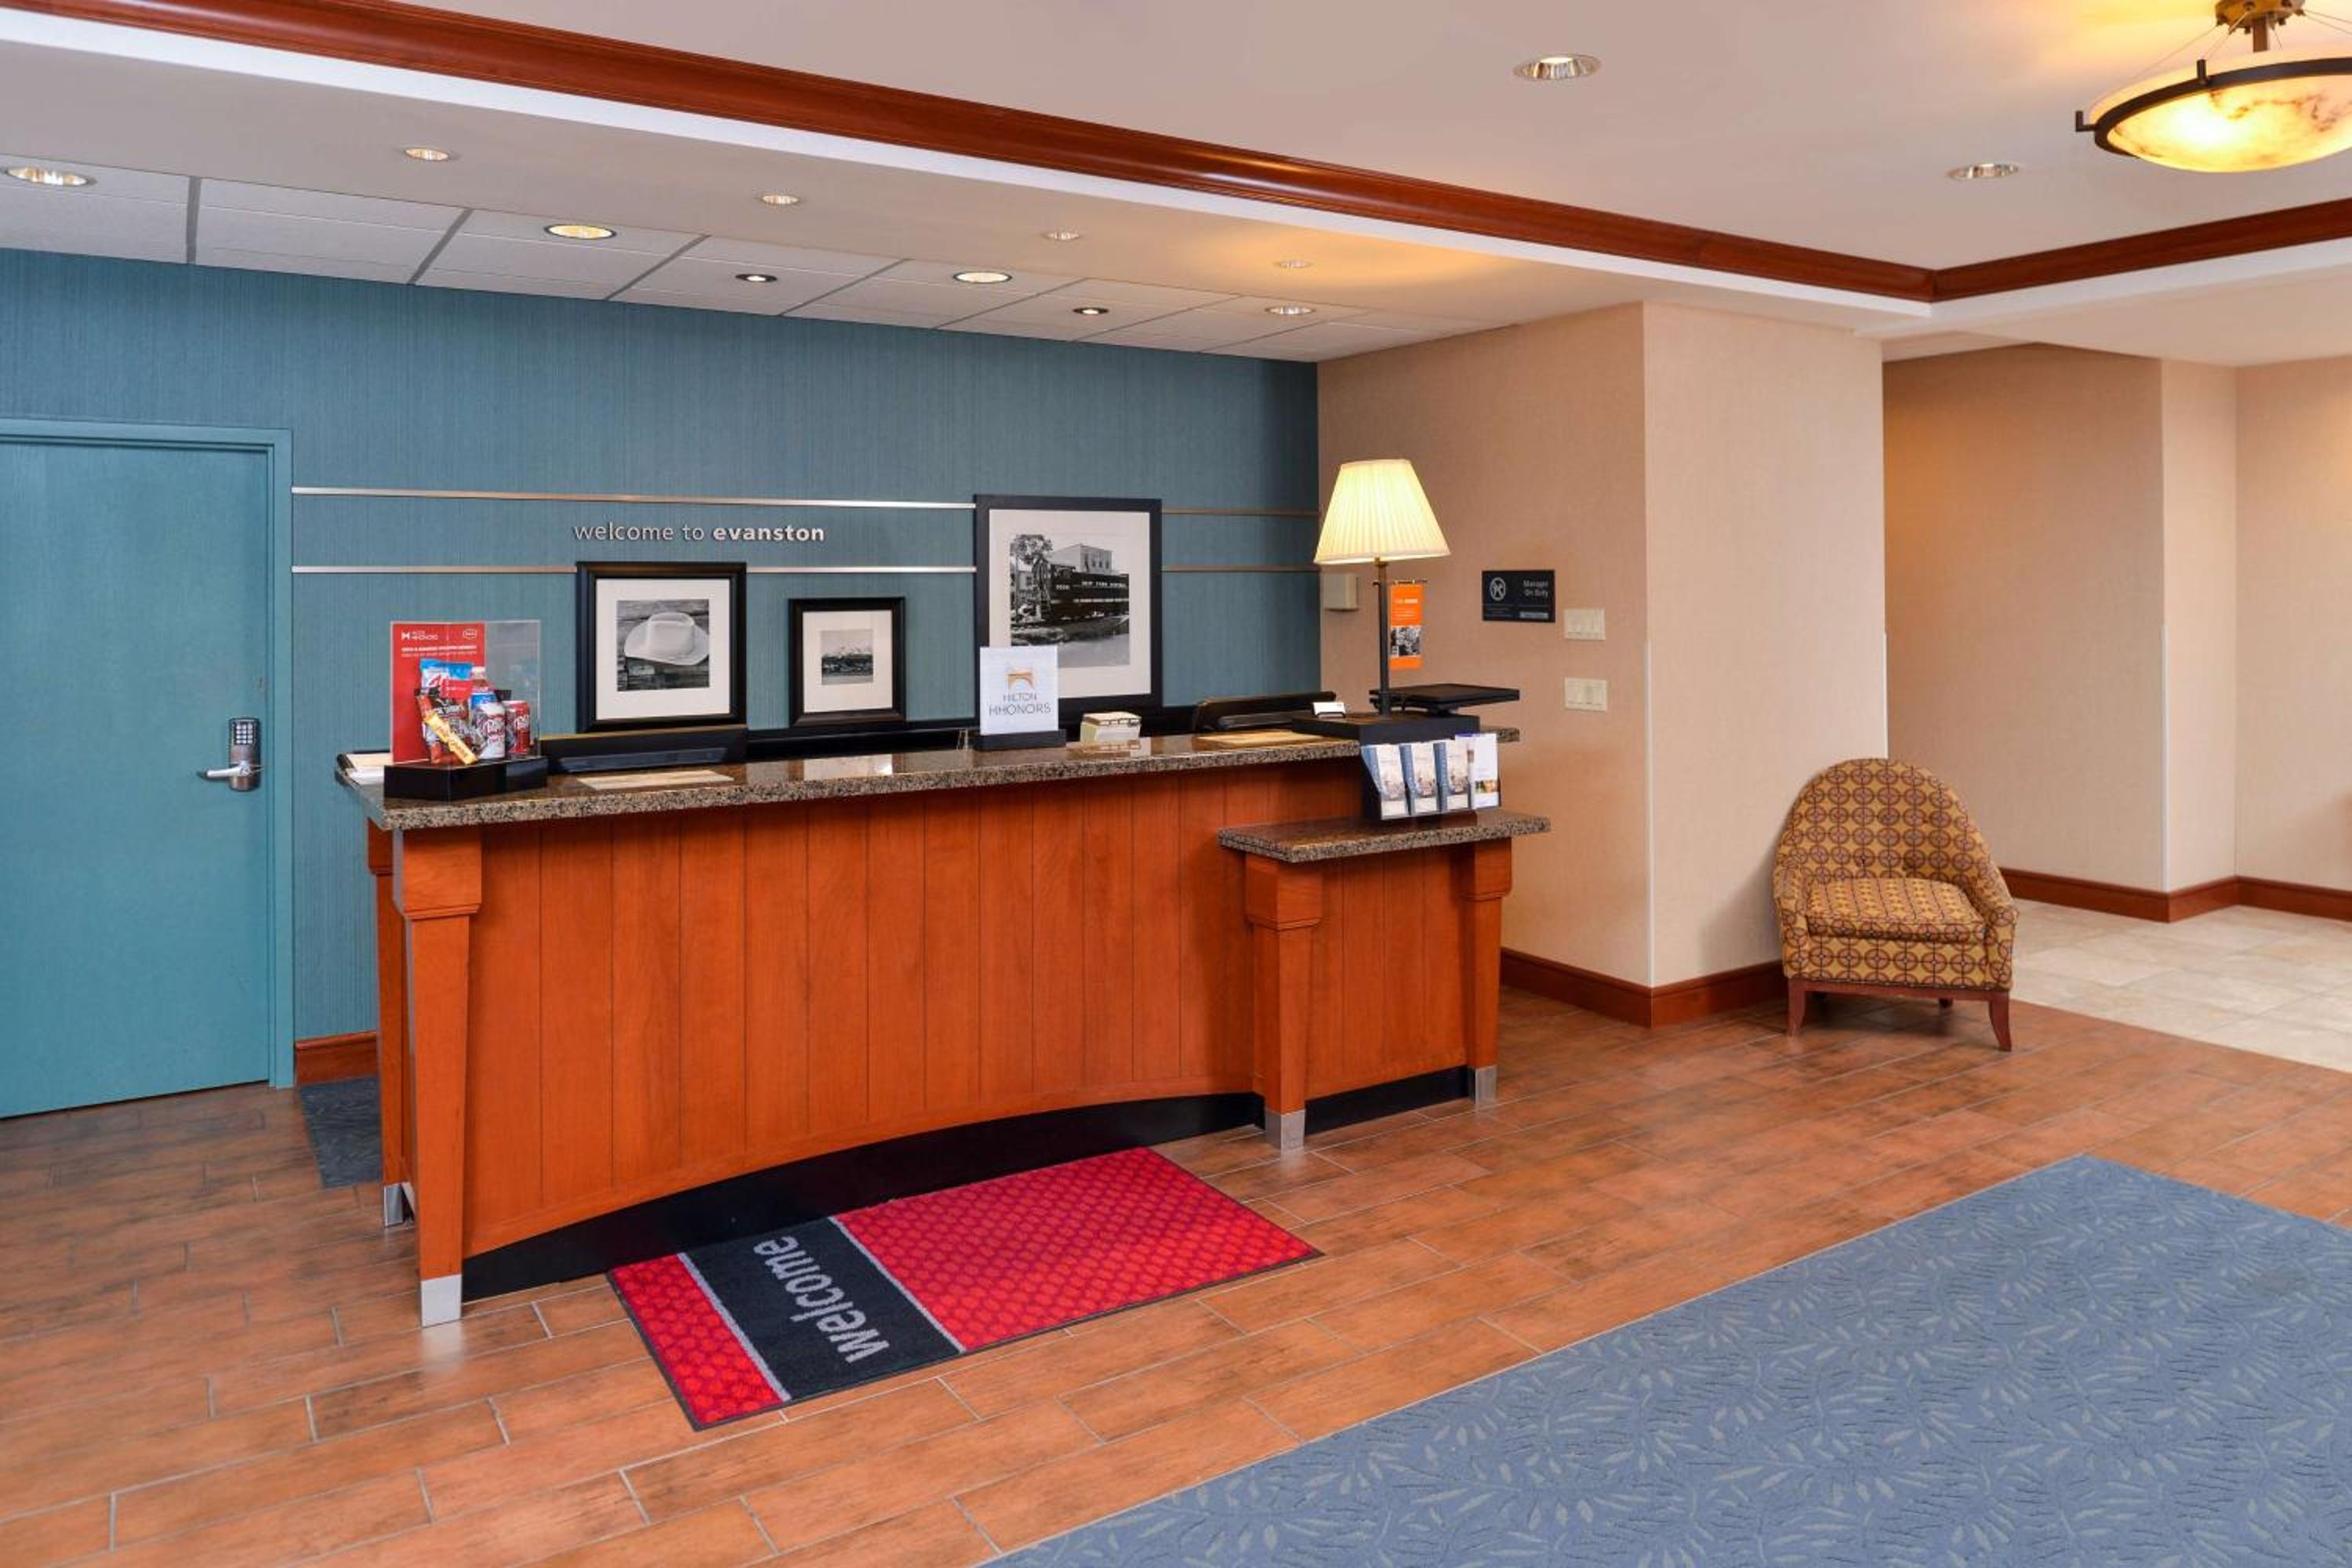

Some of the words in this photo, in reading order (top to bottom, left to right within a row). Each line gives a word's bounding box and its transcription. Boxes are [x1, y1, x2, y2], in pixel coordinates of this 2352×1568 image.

[574, 521, 673, 541] welcome
[682, 524, 705, 541] to
[713, 524, 825, 542] evanston
[1003, 692, 1037, 702] HILTON
[989, 702, 1051, 716] HHONORS
[753, 1235, 891, 1364] welcome
